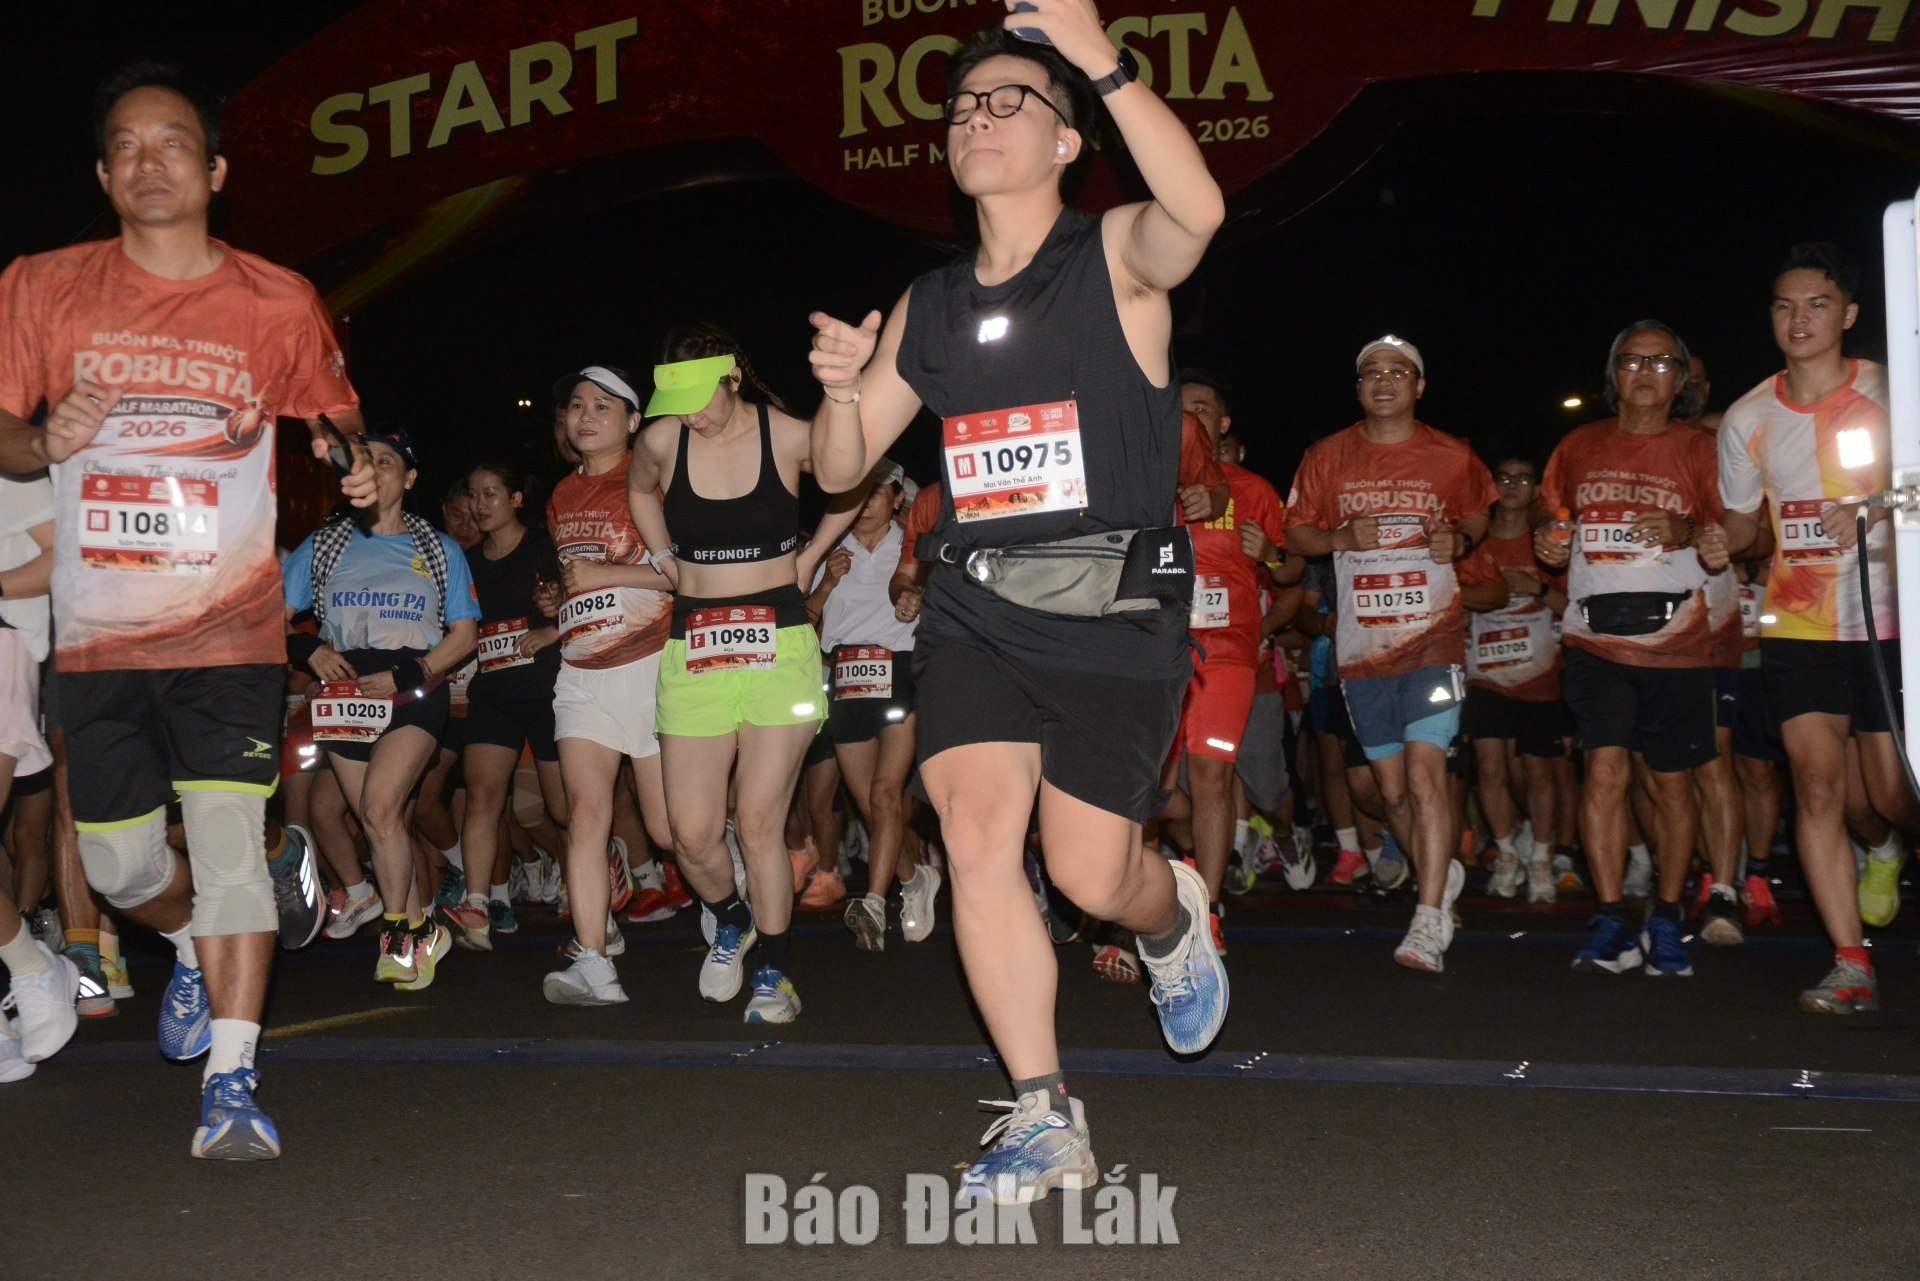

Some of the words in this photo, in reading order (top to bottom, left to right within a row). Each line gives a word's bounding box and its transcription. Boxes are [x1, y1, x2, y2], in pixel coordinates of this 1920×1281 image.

[310, 17, 638, 175] START
[1197, 116, 1270, 142] 2026
[843, 144, 919, 170] HALF
[91, 330, 147, 347] BUÔN
[151, 335, 182, 350] MA
[185, 339, 247, 364] THUỘT
[73, 350, 254, 403] ROBUSTA
[109, 402, 138, 414] ALF
[138, 401, 217, 417] MARATHON
[118, 420, 187, 438] 2026
[957, 457, 972, 476] M
[981, 440, 1073, 475] 10975
[1027, 475, 1043, 483] Anh
[1338, 491, 1439, 519] ROBUSTA
[1576, 482, 1684, 514] ROBUSTA
[117, 511, 209, 536] 10814
[694, 547, 762, 560] OFFONOFF
[332, 587, 400, 608] KRÔNG
[402, 593, 426, 611] PA
[569, 593, 616, 618] 10982
[1374, 590, 1424, 607] 10753
[379, 609, 423, 622] RUNNER
[488, 635, 518, 652] 1077
[694, 635, 701, 647] F
[710, 628, 770, 646] 10983
[845, 664, 887, 678] 10053
[321, 705, 328, 716] F
[336, 703, 387, 719] 10203
